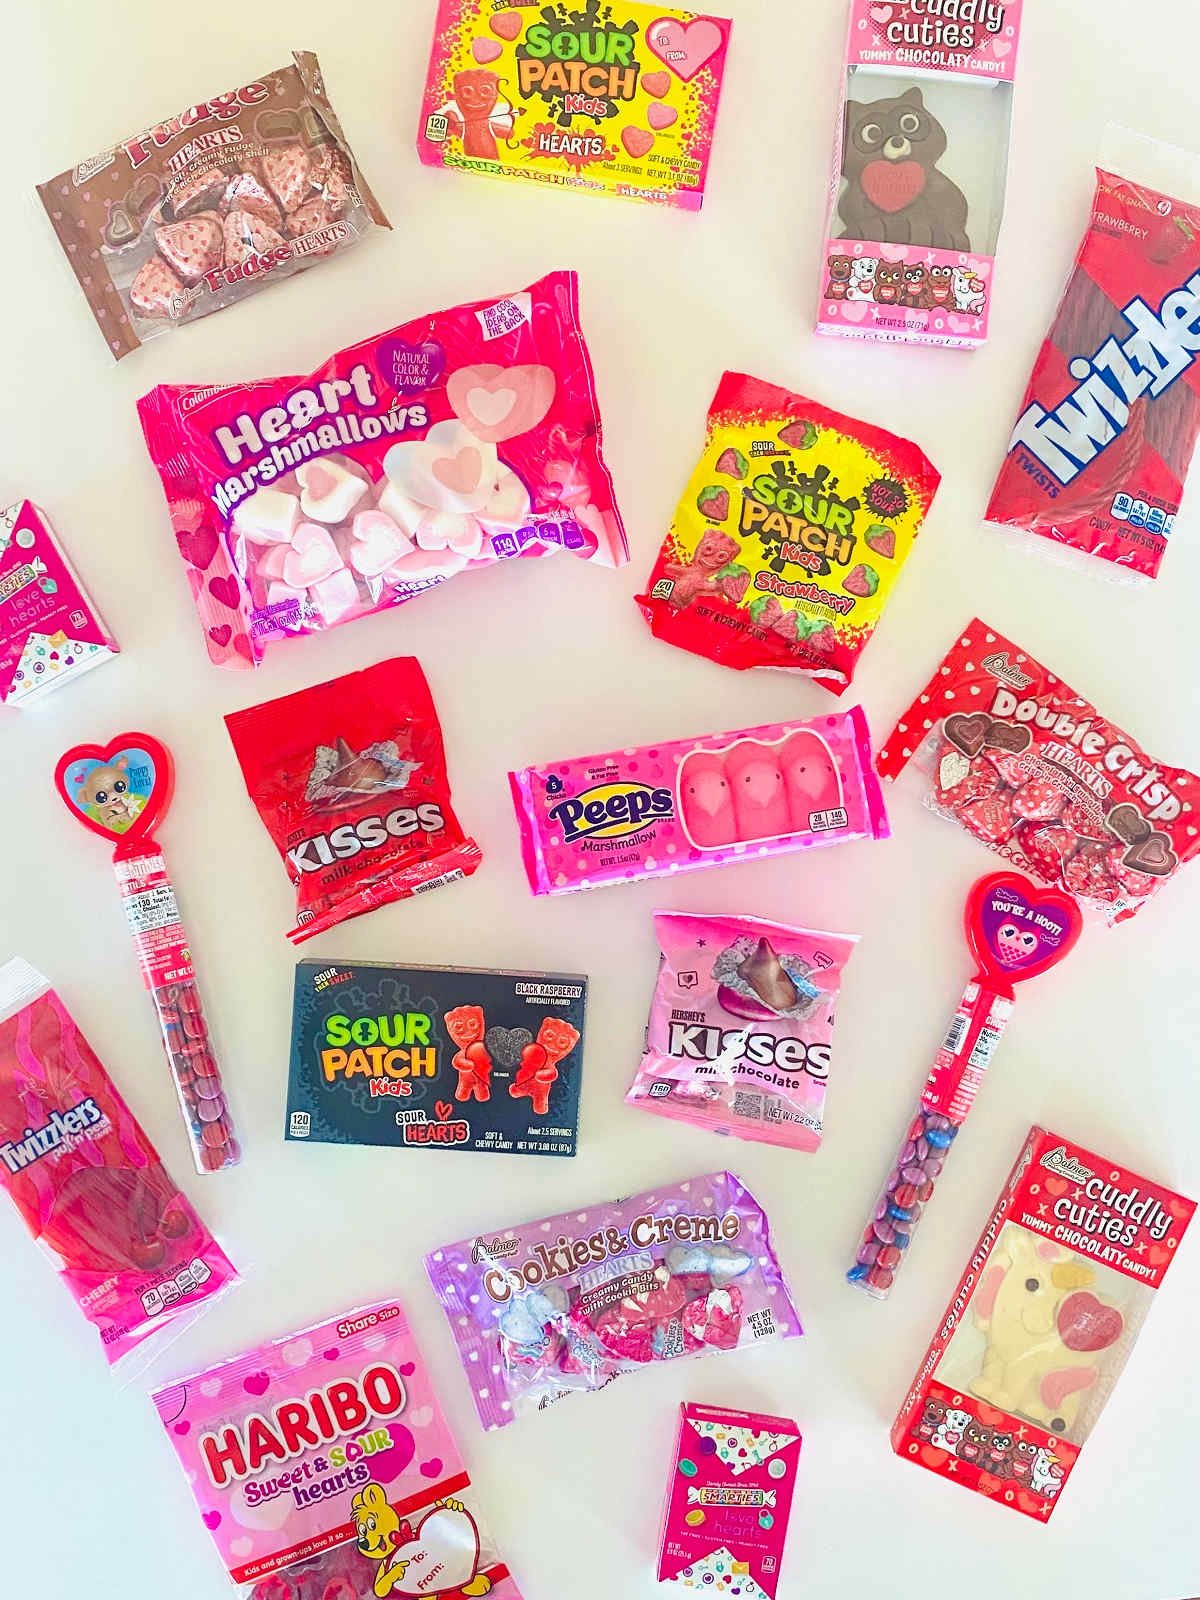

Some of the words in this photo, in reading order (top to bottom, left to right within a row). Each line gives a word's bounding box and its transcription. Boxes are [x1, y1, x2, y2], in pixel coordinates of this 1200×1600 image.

[526, 22, 635, 65] SOUR
[887, 19, 974, 48] cuties
[859, 50, 894, 61] YUMMY
[895, 48, 972, 68] CHOCOLATY
[970, 61, 1006, 73] CANDY!
[519, 60, 637, 98] PATCH
[564, 94, 607, 116] Kids
[429, 116, 447, 129] 120
[168, 125, 243, 174] HEARTS
[539, 133, 603, 156] HEARTS
[442, 155, 500, 174] SOUR
[501, 166, 564, 185] PATCH
[203, 243, 292, 293] Fudge
[291, 221, 350, 256] HEARTS
[485, 313, 506, 328] IDEAS
[488, 325, 504, 337] THE
[504, 311, 525, 330] BACK
[392, 363, 420, 375] COLOR
[393, 350, 430, 365] NATURAL
[1006, 267, 1200, 487] Twizzle
[214, 363, 377, 465] Heart
[752, 441, 775, 451] SOUR
[212, 404, 428, 519] Marshmallows
[1016, 452, 1061, 499] TWISTS
[753, 475, 854, 535] SOUR
[870, 495, 897, 514] SOUR
[1118, 496, 1129, 507] 90
[742, 498, 853, 563] PATCH
[780, 541, 823, 572] Kids
[10, 590, 40, 611] love
[754, 571, 856, 614] Strawberry
[9, 597, 56, 627] hearts
[990, 688, 1107, 756] Double
[1104, 744, 1182, 821] Crisp
[1042, 742, 1113, 799] HEARTS
[551, 782, 557, 790] 5
[548, 788, 674, 837] Peeps
[581, 830, 657, 852] Marshmallow
[321, 864, 352, 886] milk
[991, 900, 1026, 917] YOU'RE
[1025, 910, 1034, 920] A
[1036, 914, 1063, 936] HOOT!
[313, 967, 338, 985] SOUR
[516, 983, 538, 995] BLACK
[540, 984, 582, 997] RASPBERRY
[326, 1012, 431, 1048] SOUR
[671, 1009, 706, 1022] HERSHEY'S
[320, 1046, 437, 1081] PATCH
[731, 1063, 800, 1089] chocolate
[369, 1077, 413, 1097] Kids
[293, 1114, 309, 1125] 120
[397, 1112, 425, 1124] SOUR
[768, 1107, 783, 1118] NET
[0, 1097, 102, 1173] Twizzlers
[405, 1122, 468, 1144] HEARTS
[475, 1140, 495, 1148] CHEWY
[495, 1140, 513, 1149] CANDY
[517, 1141, 527, 1150] NET
[528, 1141, 537, 1150] WT
[550, 1143, 558, 1152] OZ
[549, 1128, 573, 1137] SERVINGS
[1041, 1147, 1092, 1179] Palmer
[1053, 1198, 1138, 1247] cuties
[1085, 1178, 1173, 1240] cuddly
[630, 1213, 742, 1250] Creme
[971, 1199, 1008, 1272] cuddly
[1021, 1212, 1055, 1234] YUMMY
[1054, 1224, 1127, 1265] CHOCOLATY
[1122, 1258, 1157, 1280] CANDY!
[578, 1251, 655, 1293] HEARTS
[80, 1275, 120, 1306] CHERRY
[145, 1292, 156, 1304] 70
[582, 1281, 620, 1304] Creamy
[621, 1272, 655, 1289] Candy
[582, 1302, 604, 1316] with
[606, 1289, 637, 1304] Cookie
[638, 1281, 659, 1295] Bits
[338, 1313, 378, 1338] Share
[378, 1306, 400, 1321] Size
[747, 1312, 762, 1324] NET
[761, 1309, 773, 1319] WT
[752, 1320, 763, 1330] 4.5
[762, 1318, 773, 1327] OZ
[754, 1326, 776, 1338] (128g)
[202, 1366, 402, 1485] HARIBO
[244, 1460, 314, 1505] Sweet
[314, 1457, 328, 1473] &
[329, 1429, 394, 1467] SOUR
[292, 1463, 371, 1508] hearts
[703, 1491, 759, 1502] SMARTIES
[713, 1520, 761, 1539] hearts
[244, 1565, 260, 1576] Kids
[261, 1559, 275, 1569] and
[275, 1545, 312, 1564] grown-ups
[312, 1539, 328, 1550] love
[335, 1532, 344, 1540] so
[411, 1549, 428, 1566] To:
[416, 1562, 445, 1590] From:
